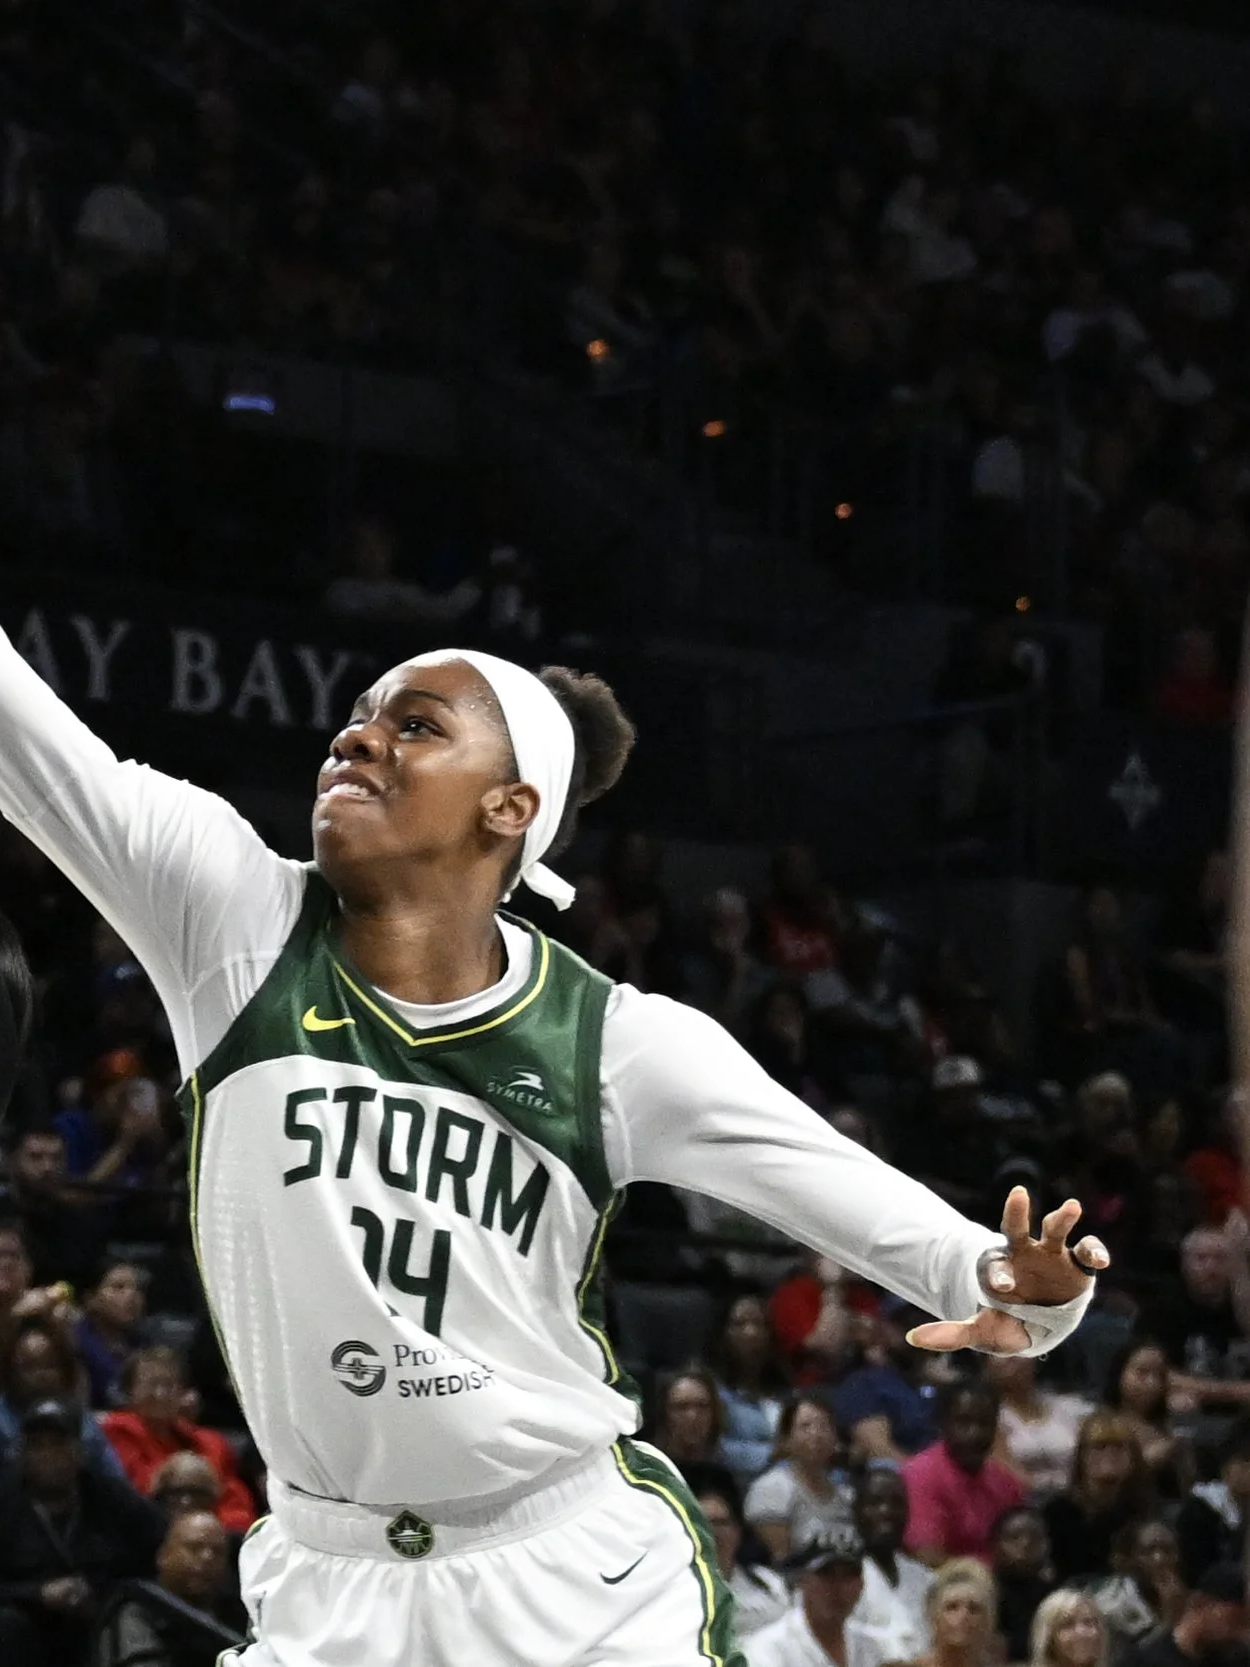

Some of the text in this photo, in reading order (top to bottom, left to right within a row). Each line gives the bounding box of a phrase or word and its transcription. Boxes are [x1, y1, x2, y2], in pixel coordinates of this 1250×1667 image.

[169, 624, 351, 731] BAY
[486, 1081, 553, 1112] SYMETRA
[283, 1085, 551, 1258] STORM
[350, 1206, 452, 1340] 14
